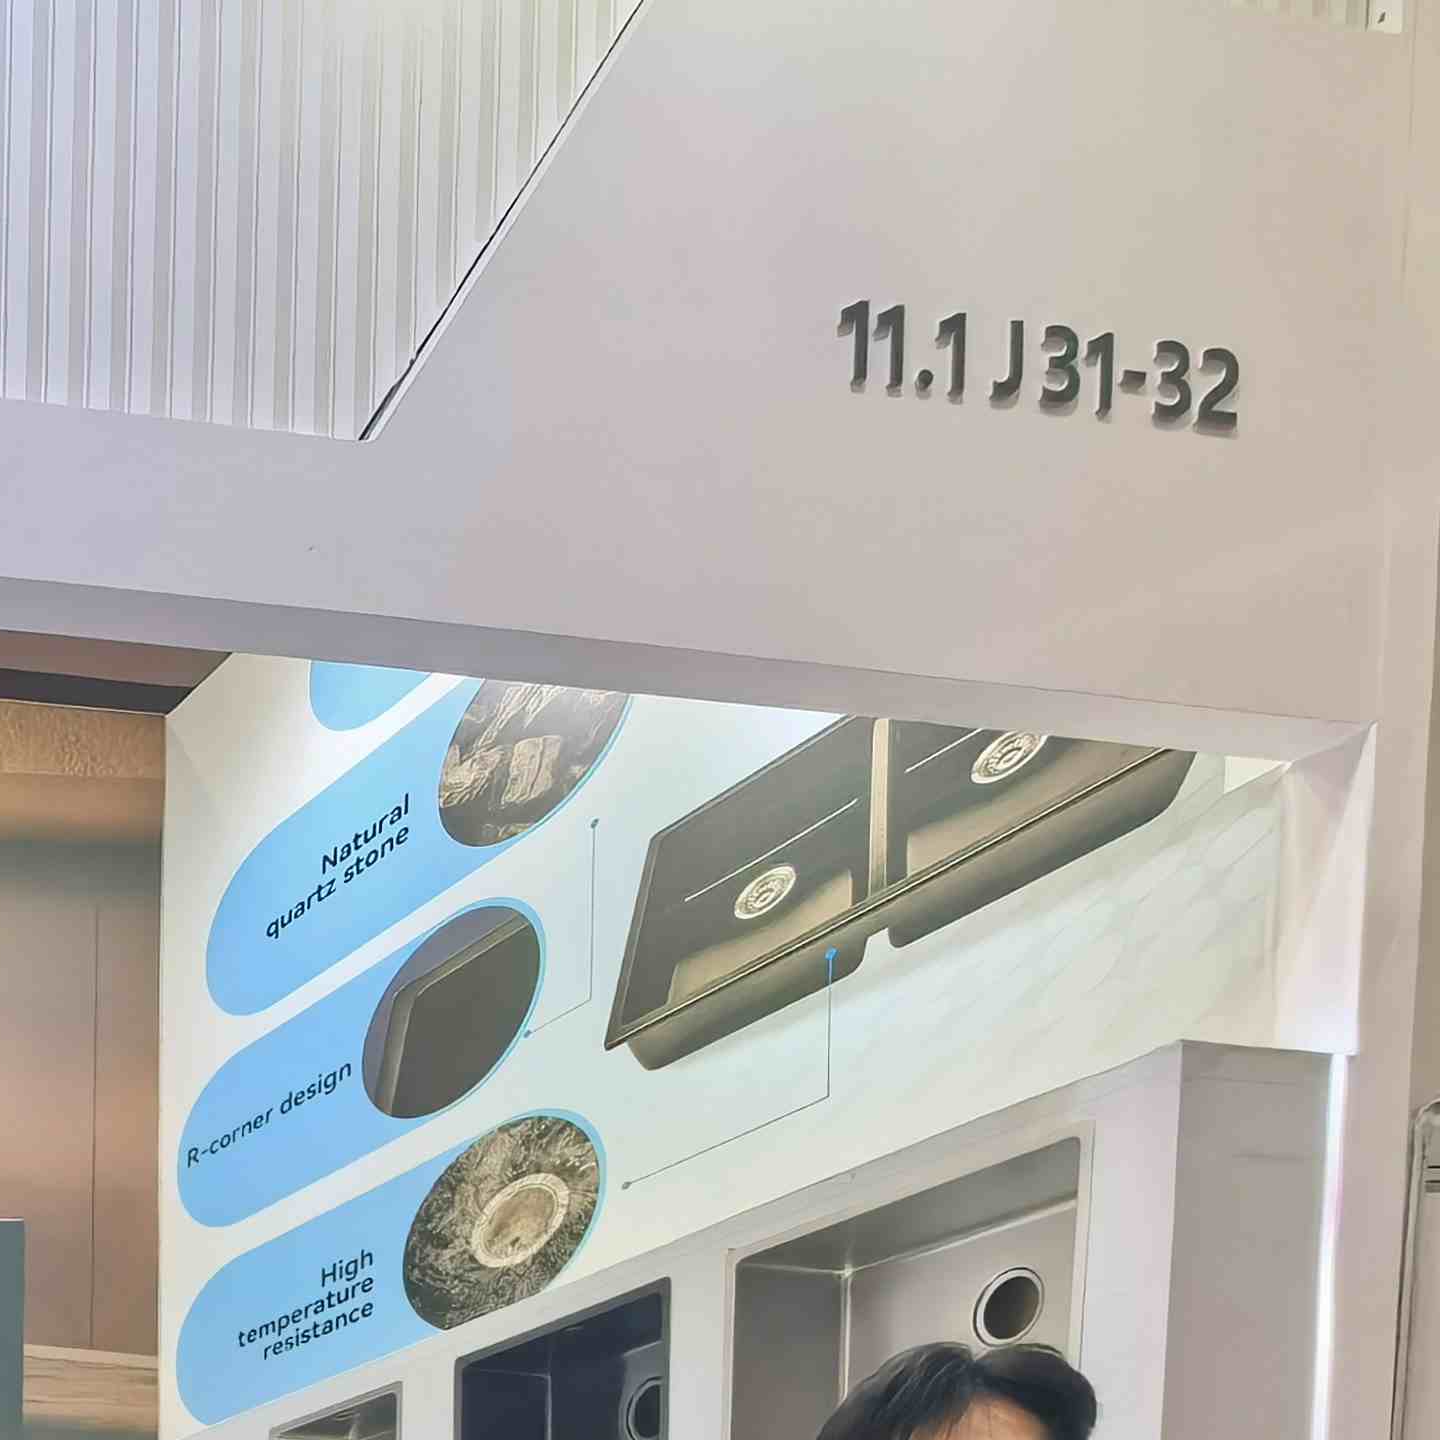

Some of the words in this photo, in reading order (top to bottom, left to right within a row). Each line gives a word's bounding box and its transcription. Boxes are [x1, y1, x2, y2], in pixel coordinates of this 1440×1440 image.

[838, 300, 967, 400] 11.1
[321, 793, 409, 874] Natural
[266, 878, 337, 939] quartz
[343, 826, 409, 883] stone
[186, 1108, 273, 1168] R-corner
[279, 1063, 352, 1115] design
[320, 1249, 374, 1288] High
[237, 1276, 374, 1347] temperature
[263, 1302, 374, 1360] resistance
